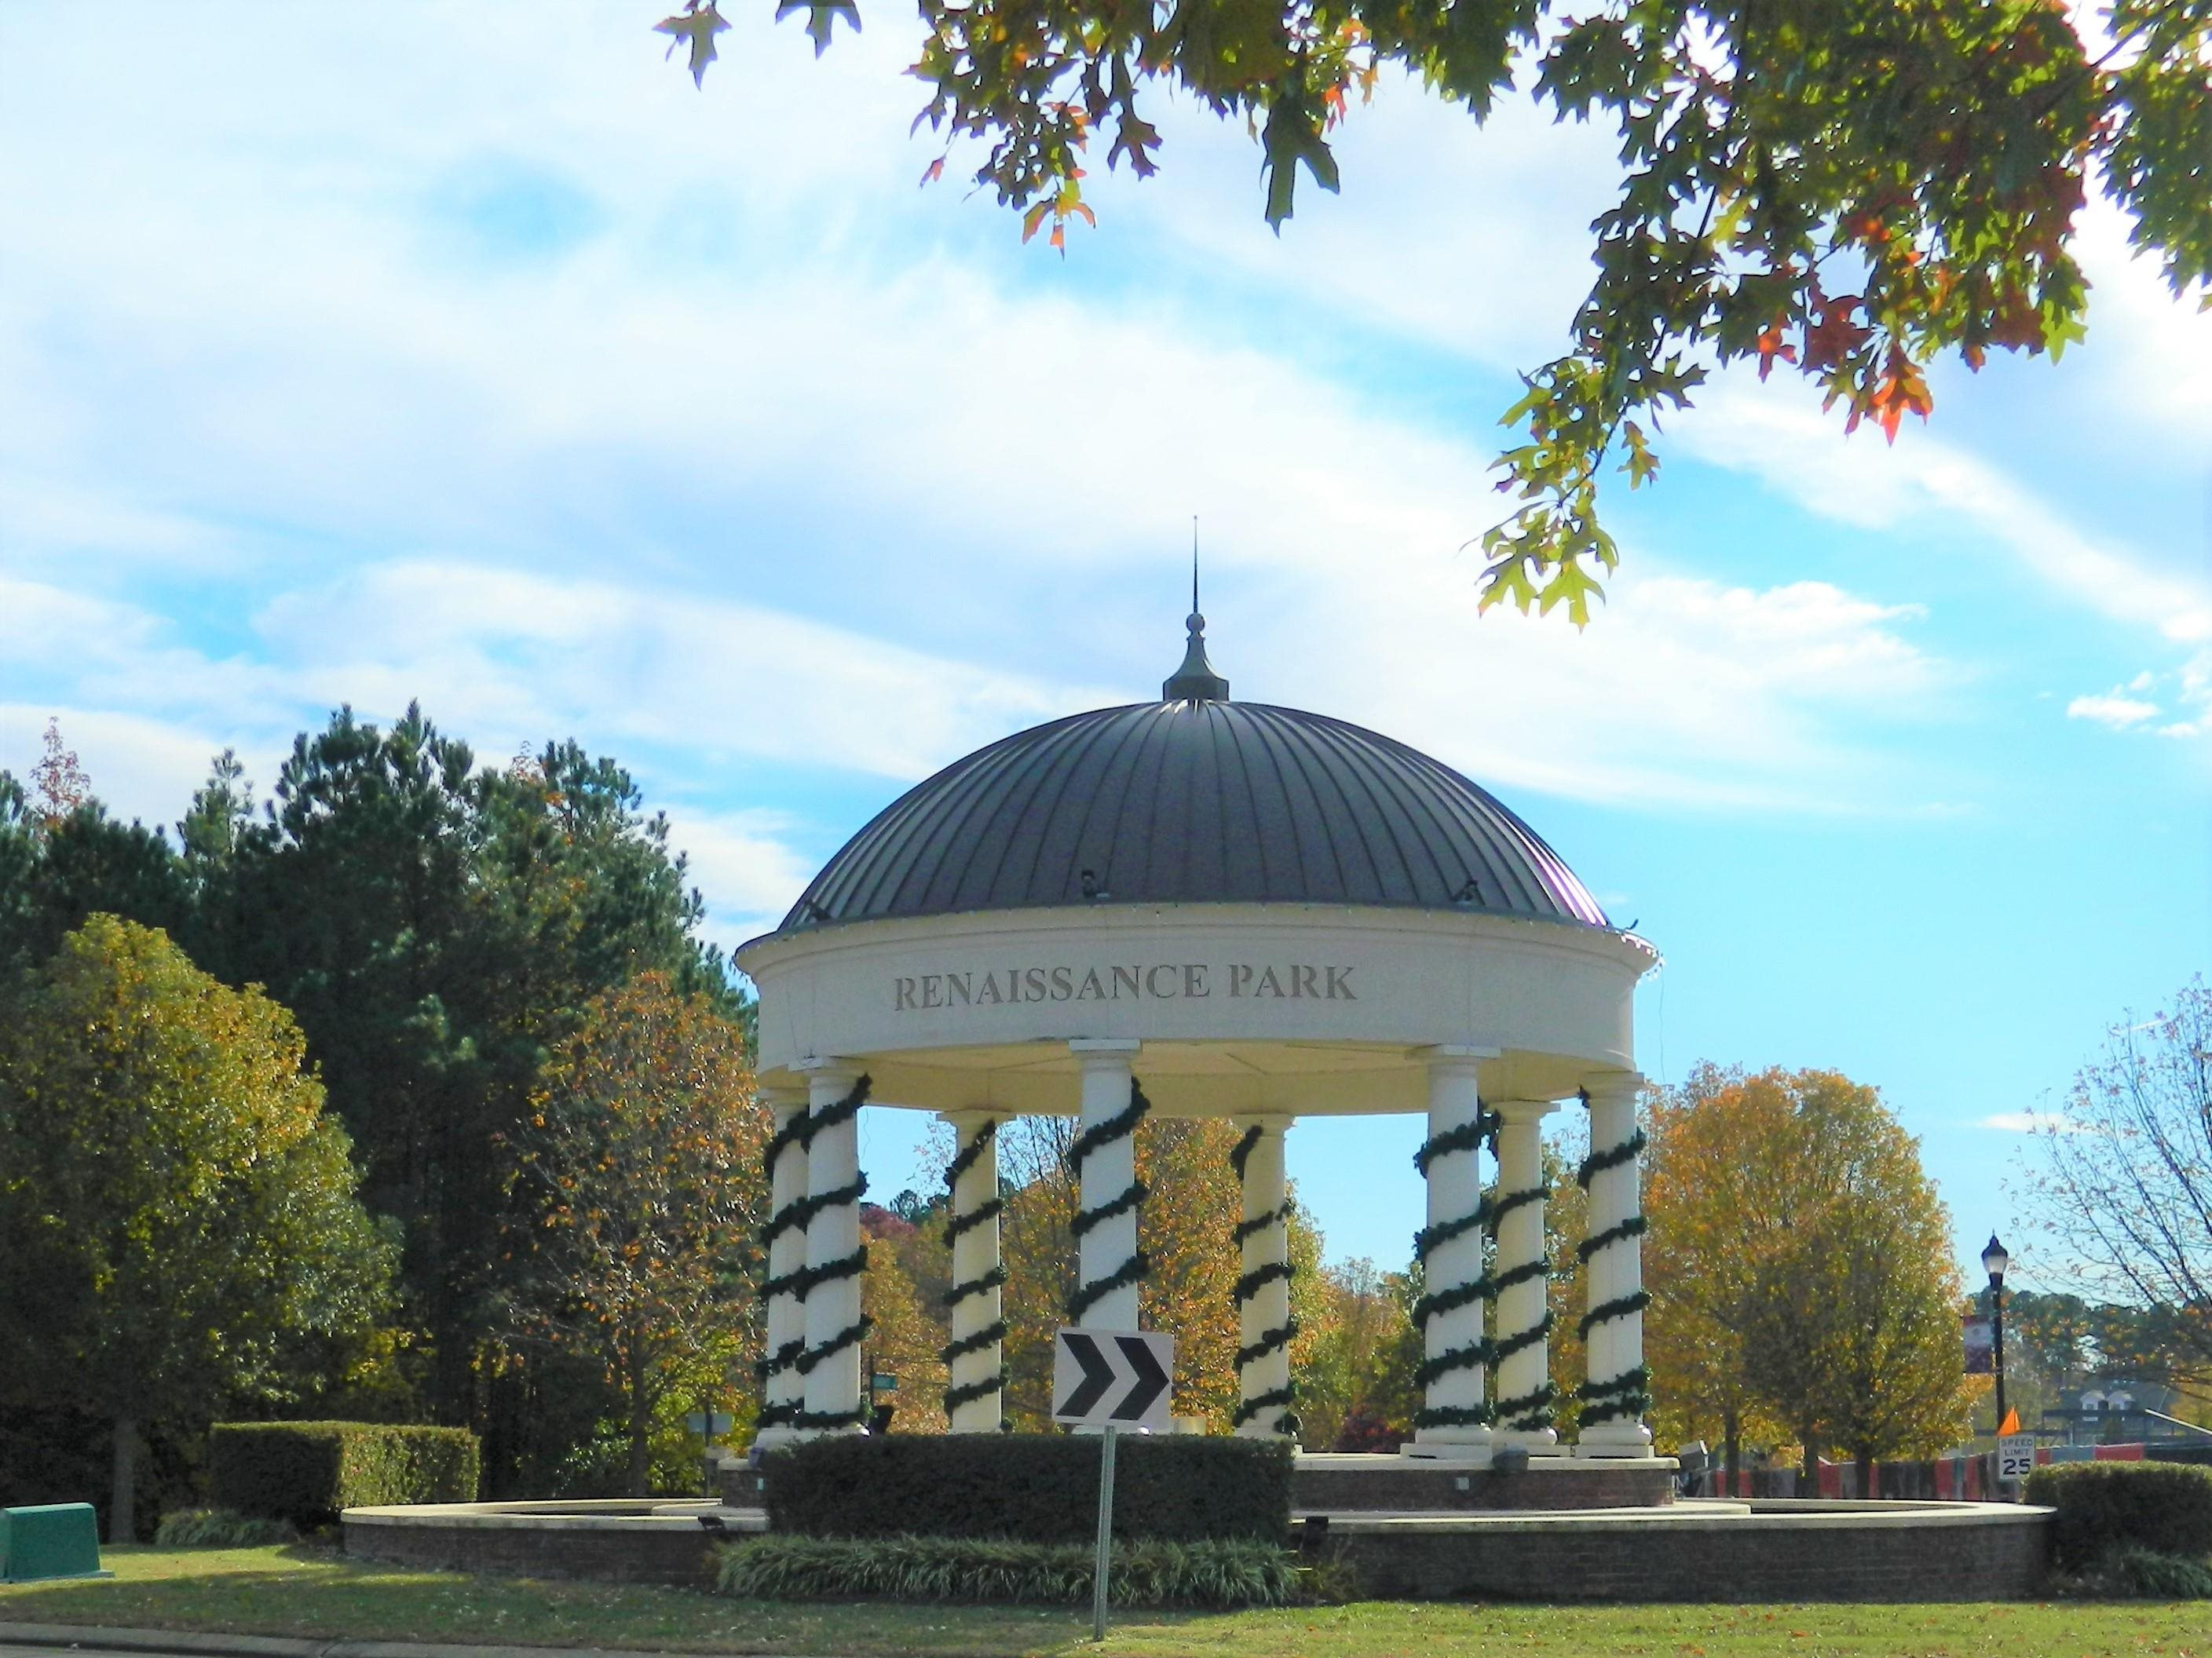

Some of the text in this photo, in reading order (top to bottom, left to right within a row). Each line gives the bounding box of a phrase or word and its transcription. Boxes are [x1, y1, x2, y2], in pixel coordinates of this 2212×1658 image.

[894, 964, 1358, 1011] RENAISSANCE PARK
[2005, 1448, 2029, 1457] LIMIT
[2003, 1459, 2031, 1475] 25
